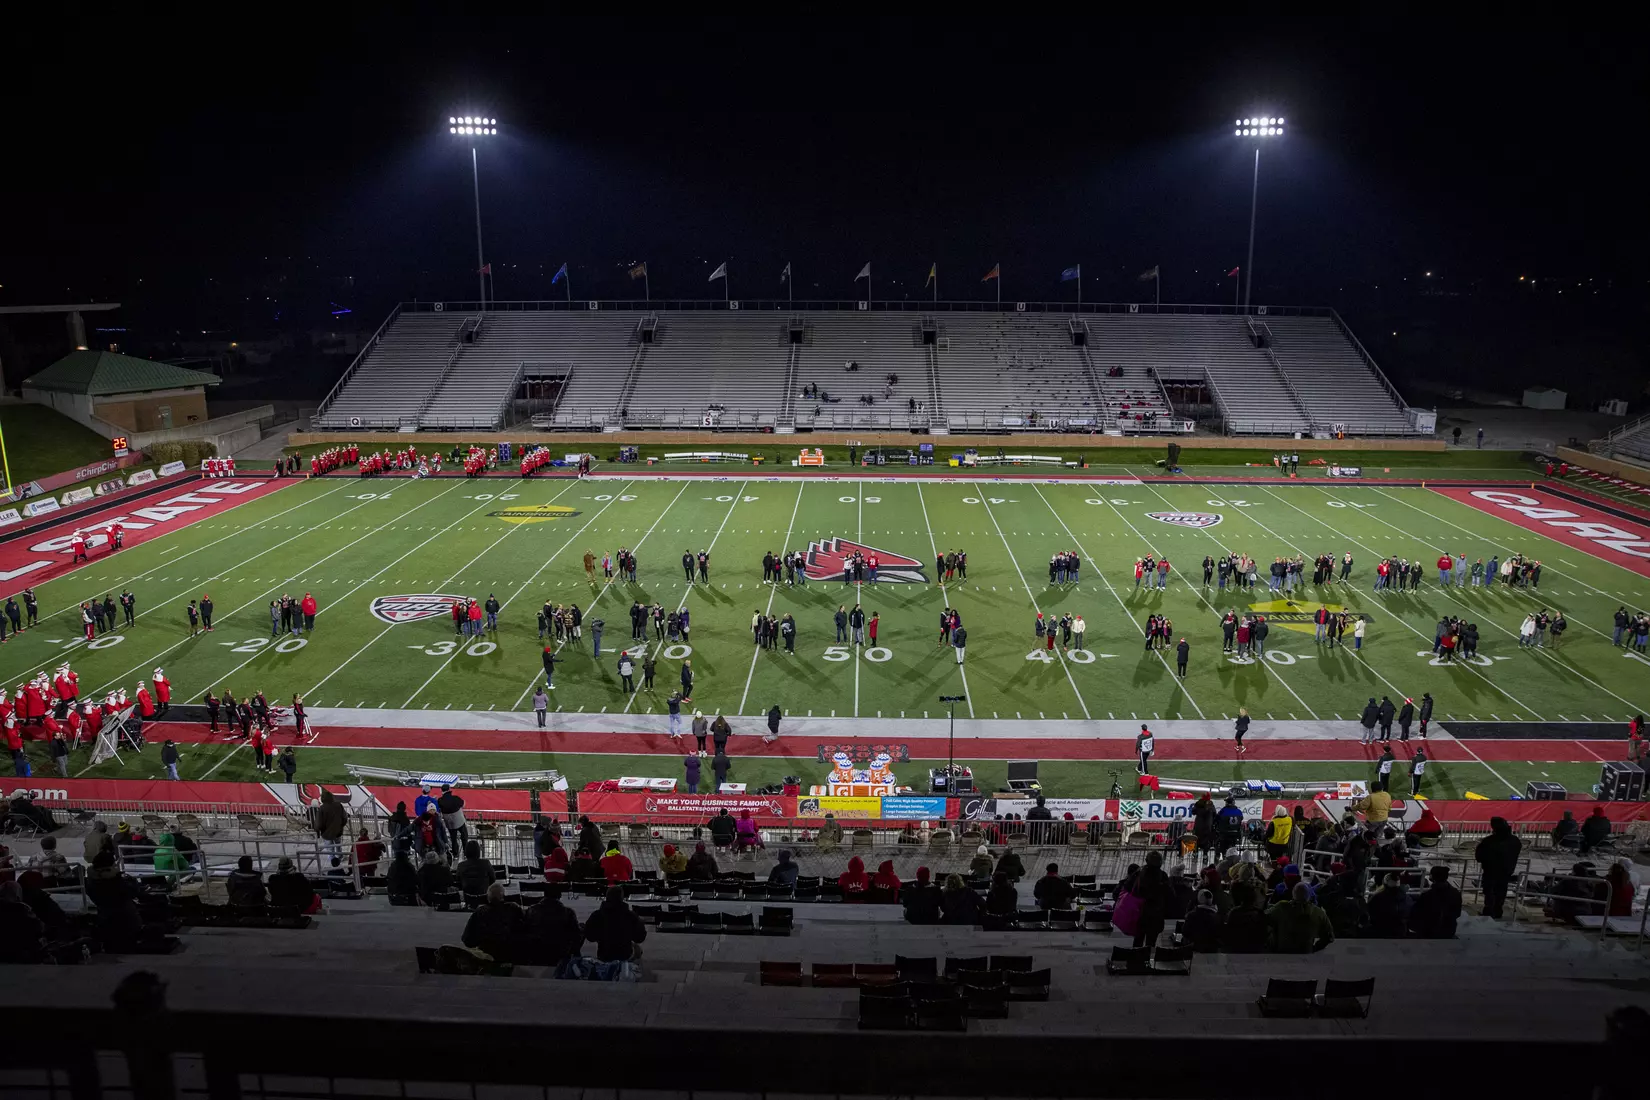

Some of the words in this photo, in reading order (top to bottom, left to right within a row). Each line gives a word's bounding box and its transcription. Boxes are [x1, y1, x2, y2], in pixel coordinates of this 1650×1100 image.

[113, 437, 127, 449] 25
[61, 635, 125, 650] 10
[230, 637, 308, 653] 20
[424, 641, 498, 657] 30
[822, 646, 893, 662] 50
[1025, 648, 1097, 664] 40
[965, 799, 990, 820] Gill
